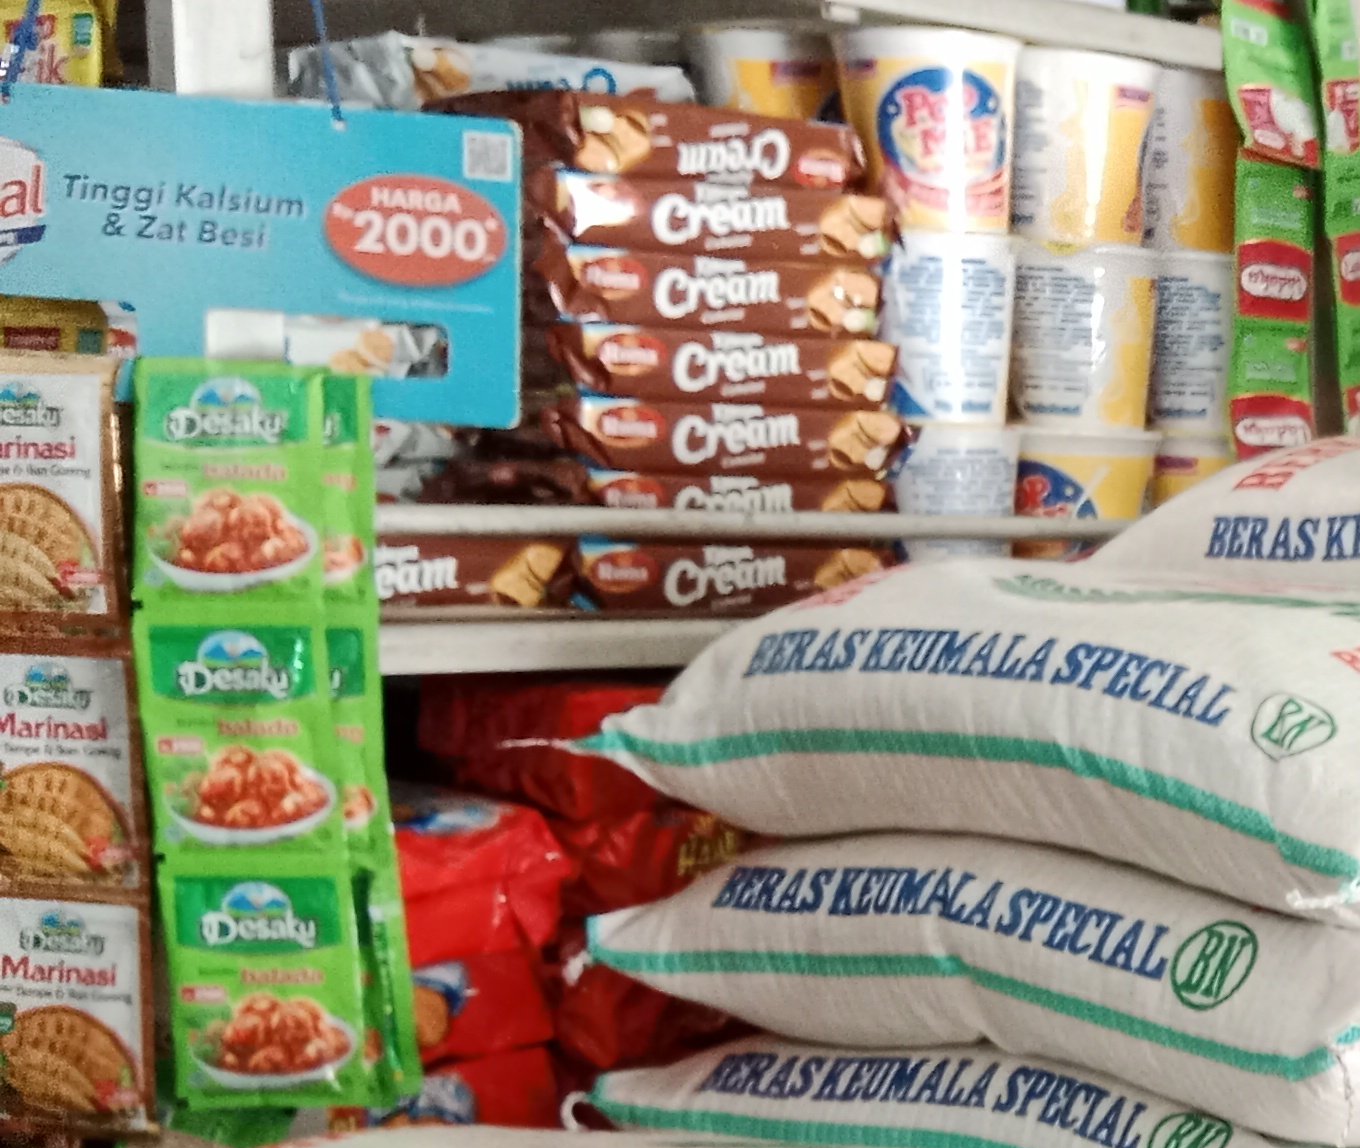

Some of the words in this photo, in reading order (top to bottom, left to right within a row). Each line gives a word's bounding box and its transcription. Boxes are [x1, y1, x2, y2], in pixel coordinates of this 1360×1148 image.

[63, 173, 166, 212] Tinggi
[175, 182, 304, 218] Kalsium
[370, 186, 462, 214] HARGA
[102, 211, 126, 237] &
[136, 214, 187, 243] Zat
[197, 220, 268, 249] Besi
[652, 194, 791, 246] Cream
[654, 267, 781, 319] Cream
[672, 341, 801, 393] Cream
[0, 402, 63, 428] esaku
[165, 405, 288, 443] Desaku
[672, 413, 801, 465] Cream
[1205, 513, 1320, 560] BERAS
[376, 555, 458, 600] eam
[664, 556, 787, 607] Cream
[176, 660, 292, 699] Desaku
[743, 627, 866, 679] BERAS
[858, 627, 1049, 683] KEUMALA
[1050, 641, 1240, 730] SPECIAL
[200, 908, 319, 949] Desaku
[712, 863, 828, 916] BERAS
[824, 865, 998, 931] KEUMALA
[997, 889, 1170, 982] SPECIAL
[1, 954, 118, 987] Marinasi
[1179, 926, 1252, 1003] BN
[700, 1052, 816, 1097] BERAS
[810, 1050, 989, 1109] KEUMALA
